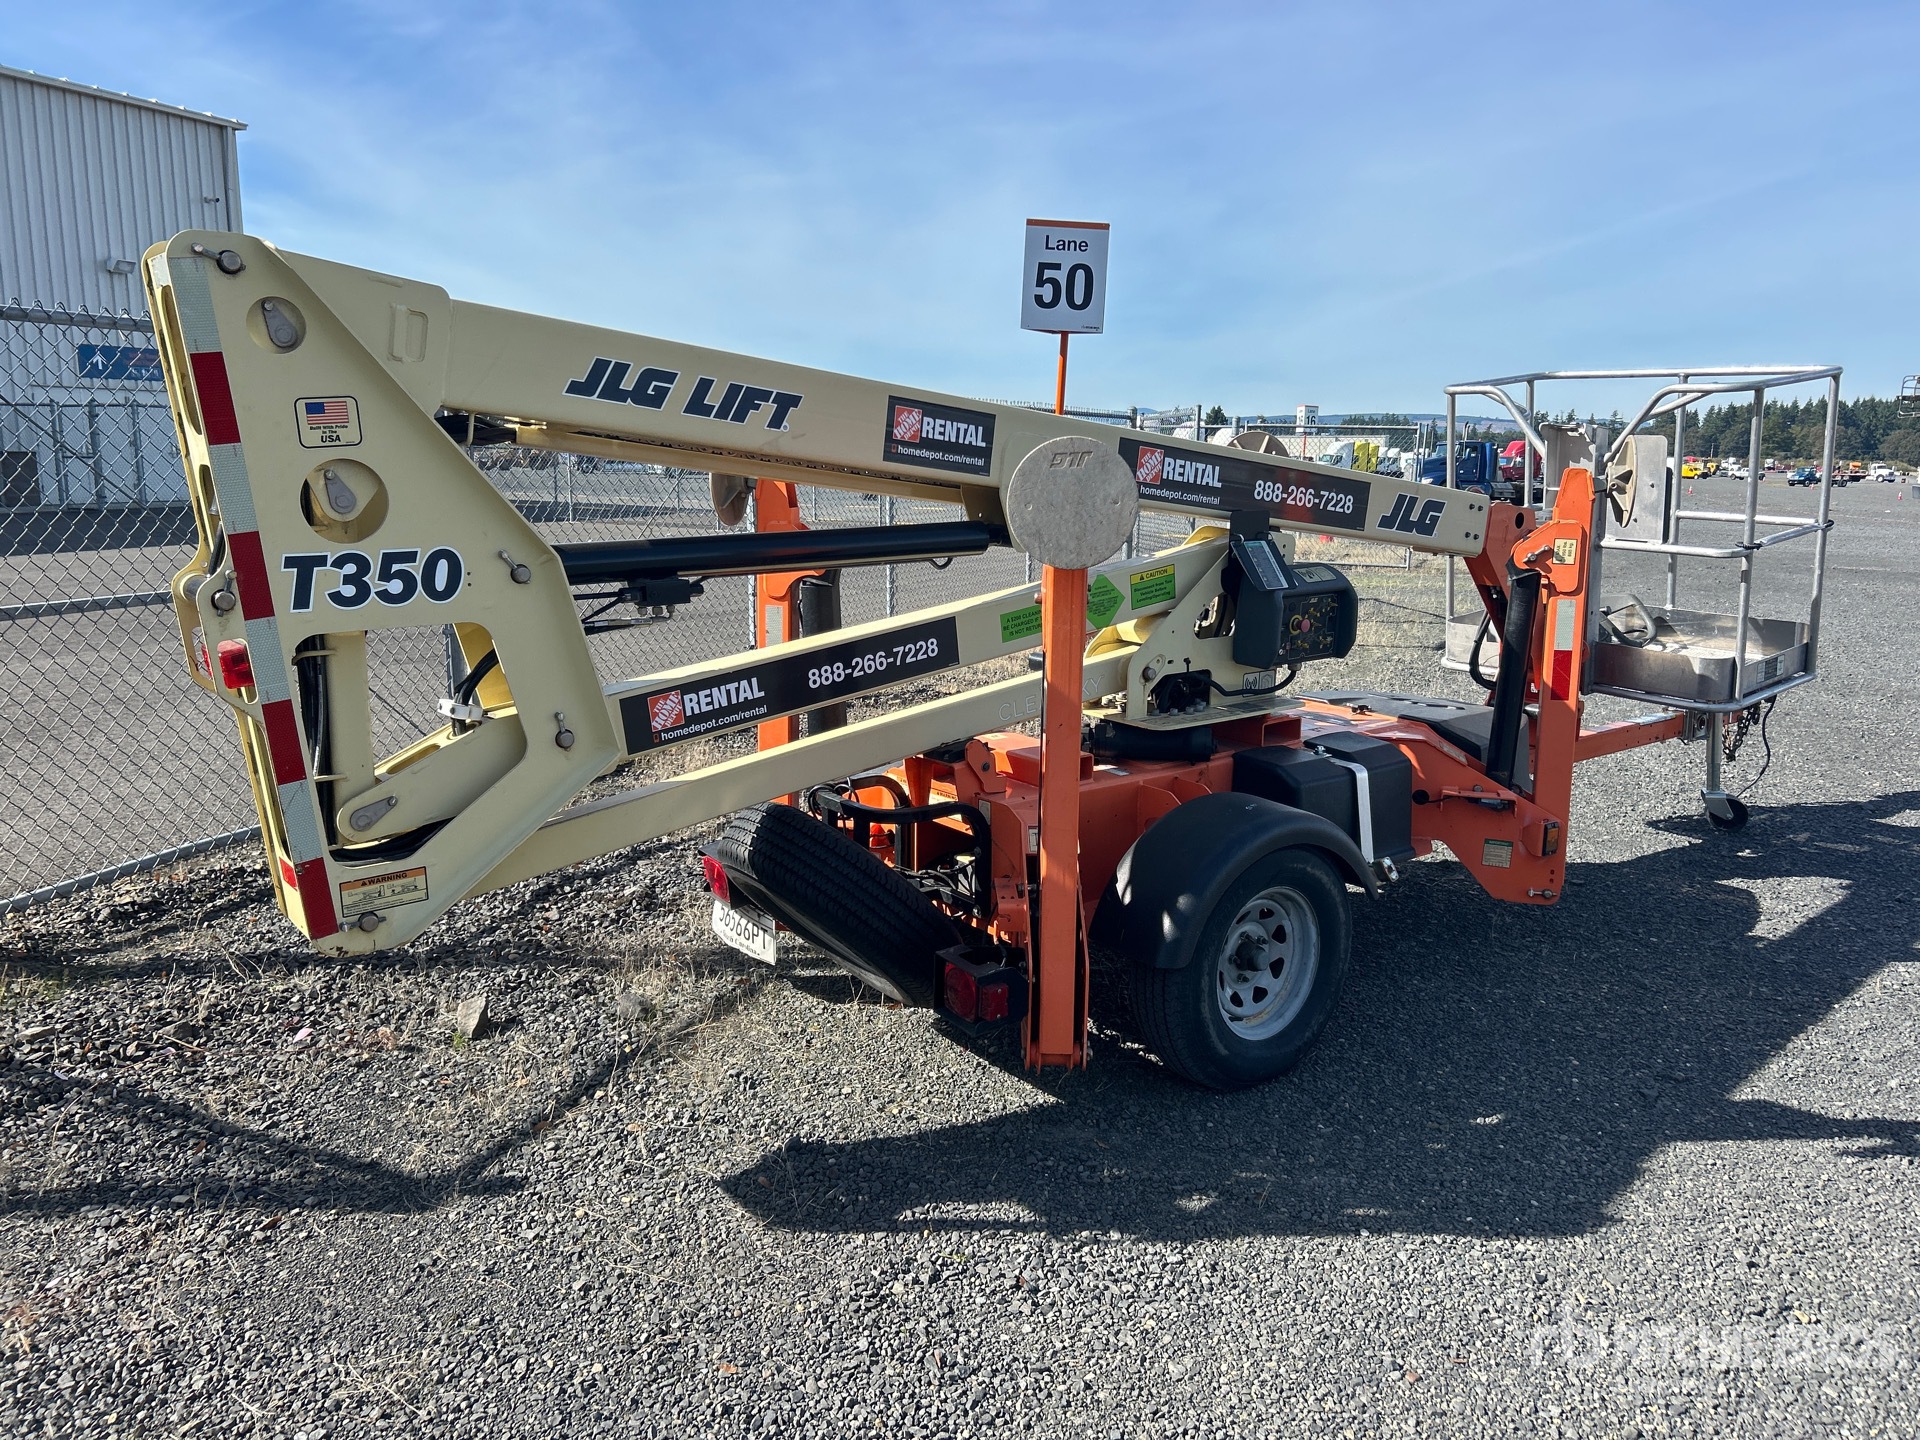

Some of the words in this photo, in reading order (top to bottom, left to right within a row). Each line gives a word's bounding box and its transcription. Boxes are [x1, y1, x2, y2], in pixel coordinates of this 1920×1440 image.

[1045, 235, 1088, 252] Lane
[1034, 262, 1094, 311] 50
[562, 356, 680, 411] JLG
[681, 375, 804, 431] LIFT
[894, 409, 922, 439] HOME
[898, 411, 909, 423] THE
[904, 421, 920, 440] DEPOT
[921, 417, 986, 447] RENTAL
[321, 434, 341, 443] USA
[897, 445, 985, 466] homedepot.com/rental
[1137, 450, 1163, 481] HOME
[1141, 451, 1152, 464] THE
[1146, 463, 1162, 482] DEPOT
[1162, 457, 1222, 487] RENTAL
[1140, 485, 1220, 505] homedepot.com/rental
[1254, 480, 1353, 514] 888-266-7228
[1376, 492, 1446, 537] JLG
[280, 546, 464, 612] T350
[1145, 569, 1168, 579] CAUTION
[808, 638, 938, 689] 888-266-7228
[652, 692, 680, 730] HOME
[653, 698, 666, 713] THE
[683, 677, 765, 717] RENTAL
[661, 705, 767, 741] homedepot.com/rental
[665, 703, 682, 727] DEPOT
[367, 872, 408, 885] WARNING
